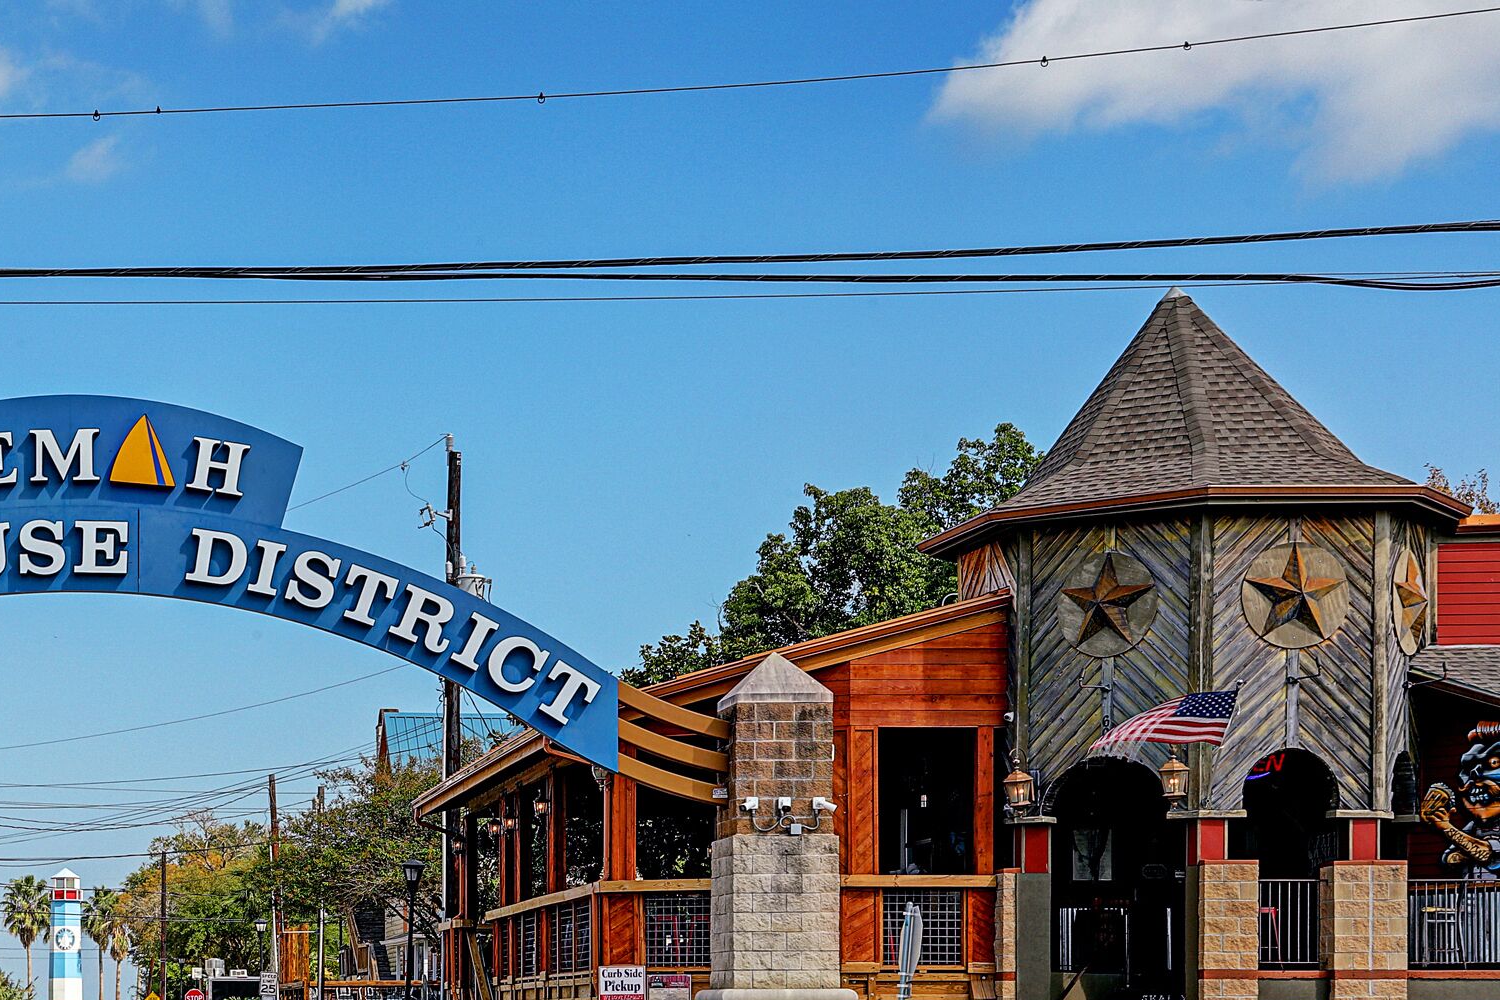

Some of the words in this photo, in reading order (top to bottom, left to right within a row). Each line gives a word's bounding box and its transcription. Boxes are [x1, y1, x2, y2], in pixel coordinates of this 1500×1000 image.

[185, 528, 601, 725] DISTRICT
[602, 969, 622, 978] Curb
[624, 968, 643, 978] Side
[261, 984, 276, 994] 25
[604, 980, 641, 994] Pickup
